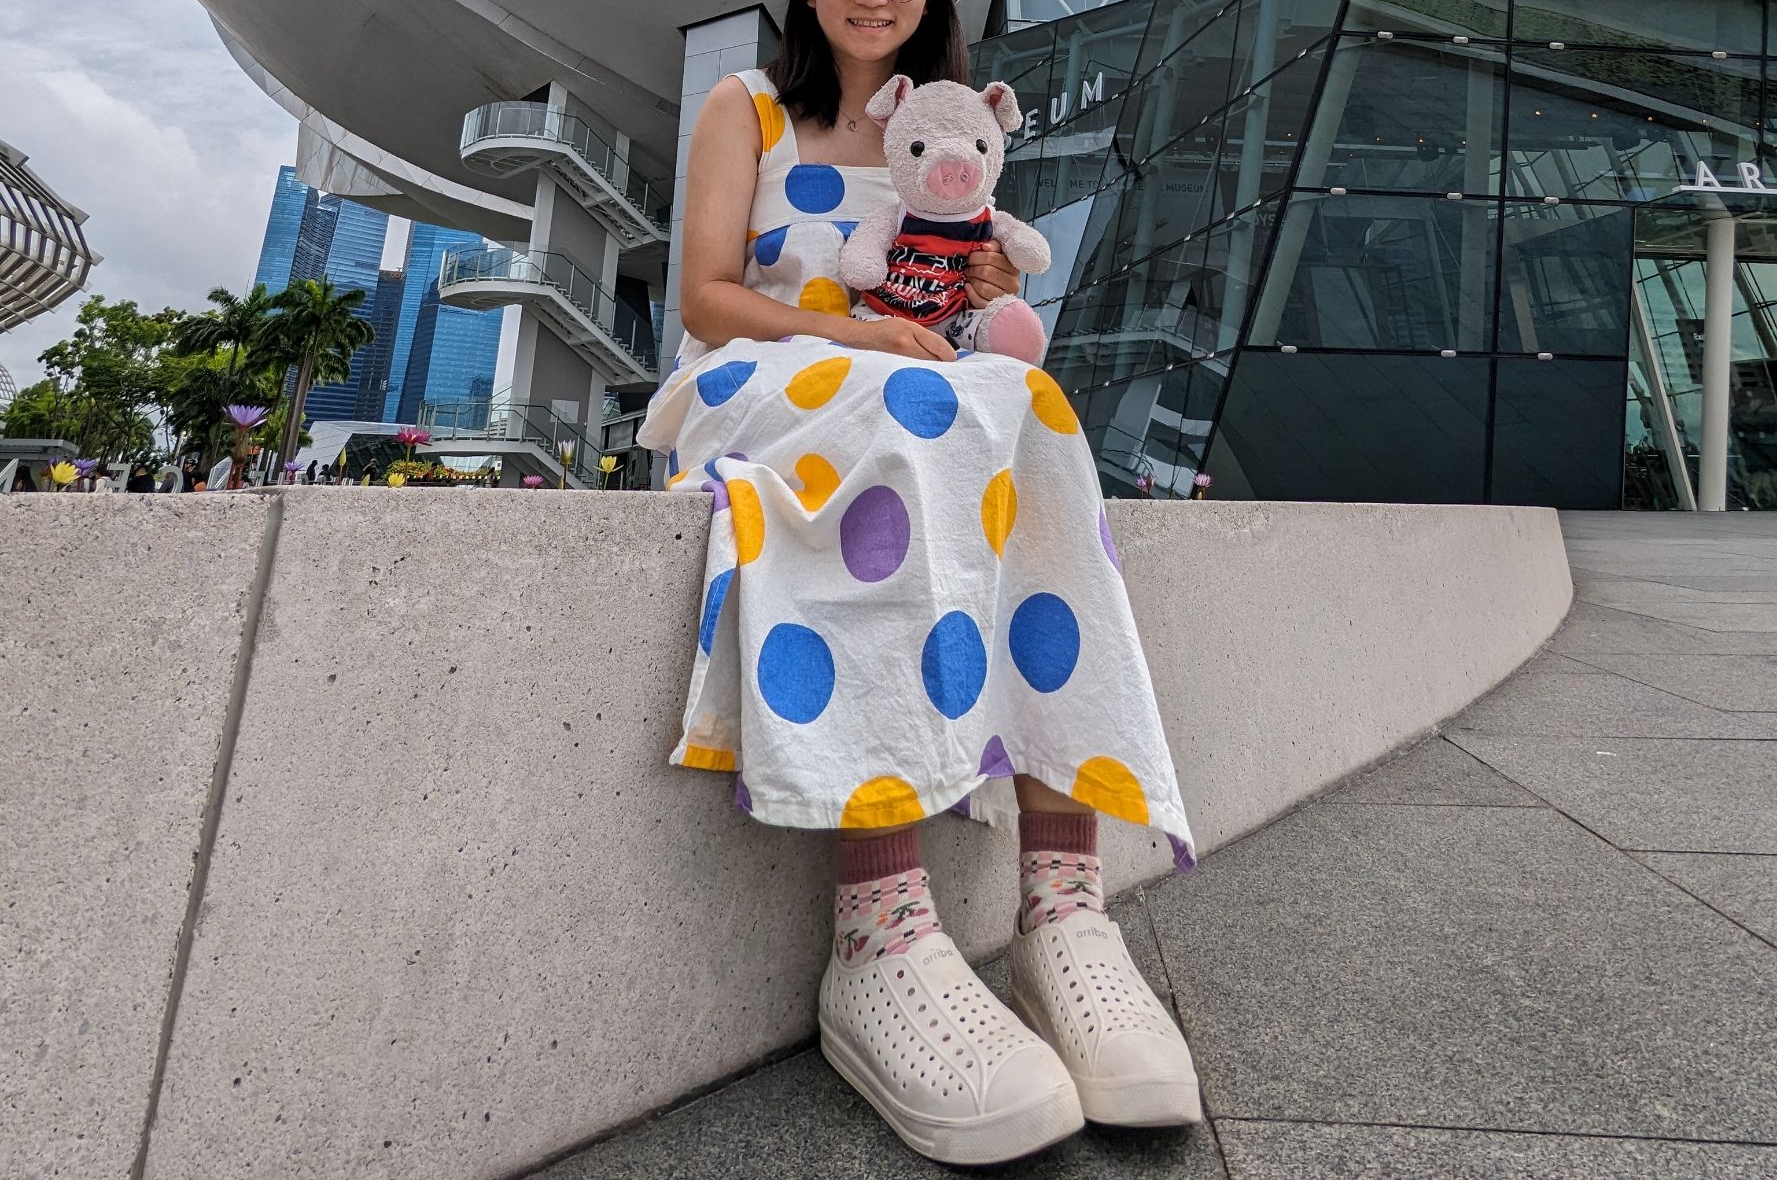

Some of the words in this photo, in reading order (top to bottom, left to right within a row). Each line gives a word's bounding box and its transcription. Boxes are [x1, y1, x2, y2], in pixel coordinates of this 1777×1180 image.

[1004, 72, 1104, 151] EUM
[1695, 161, 1766, 189] AR
[1076, 927, 1108, 939] arriba
[922, 949, 953, 965] arriba
